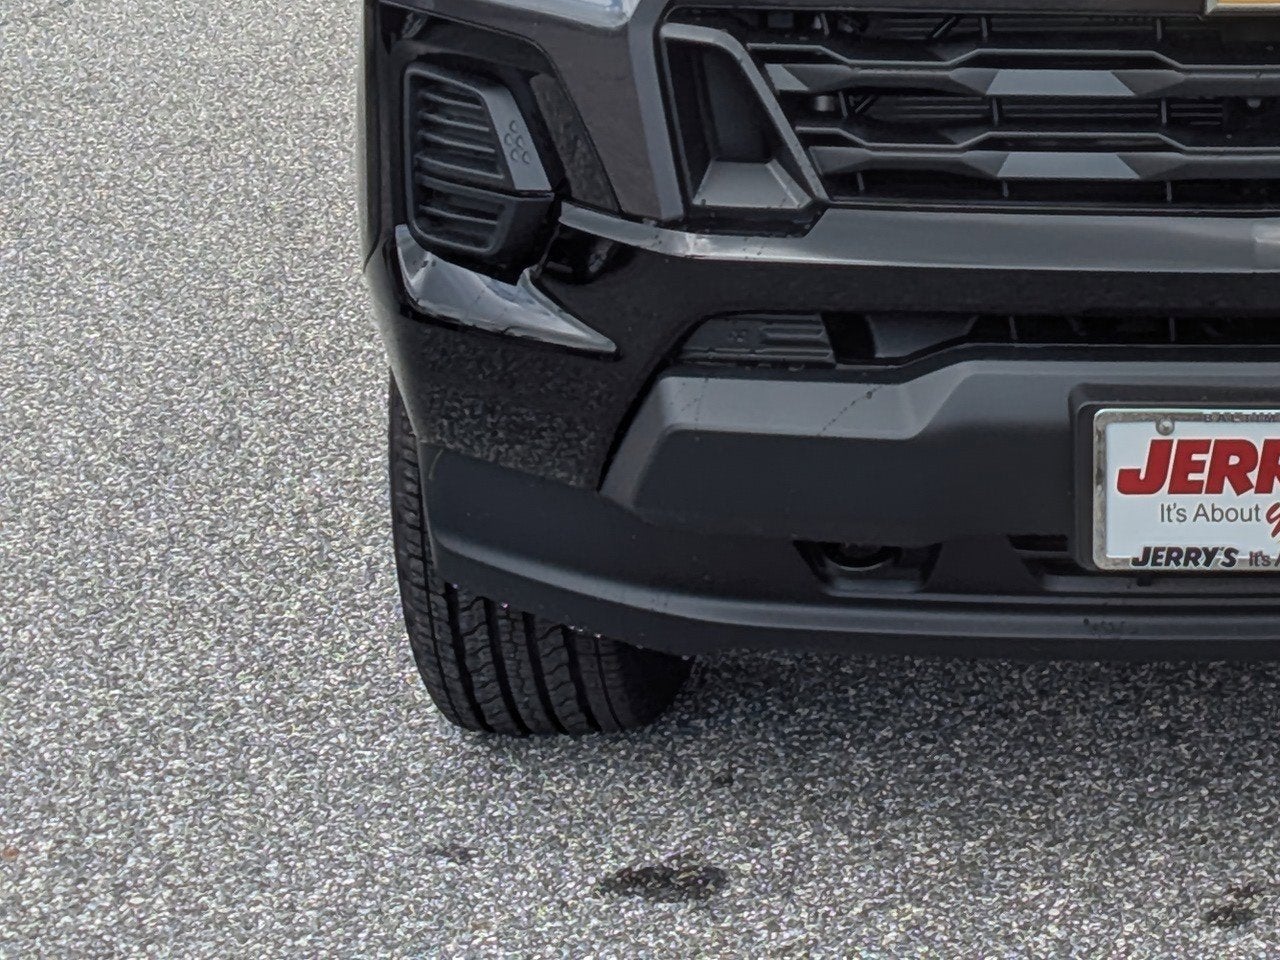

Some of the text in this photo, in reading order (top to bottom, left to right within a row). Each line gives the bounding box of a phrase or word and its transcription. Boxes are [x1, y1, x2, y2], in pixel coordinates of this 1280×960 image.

[1160, 503, 1187, 523] It's
[1193, 503, 1261, 523] About
[1131, 546, 1239, 568] JERRY'S
[1249, 551, 1271, 567] It's
